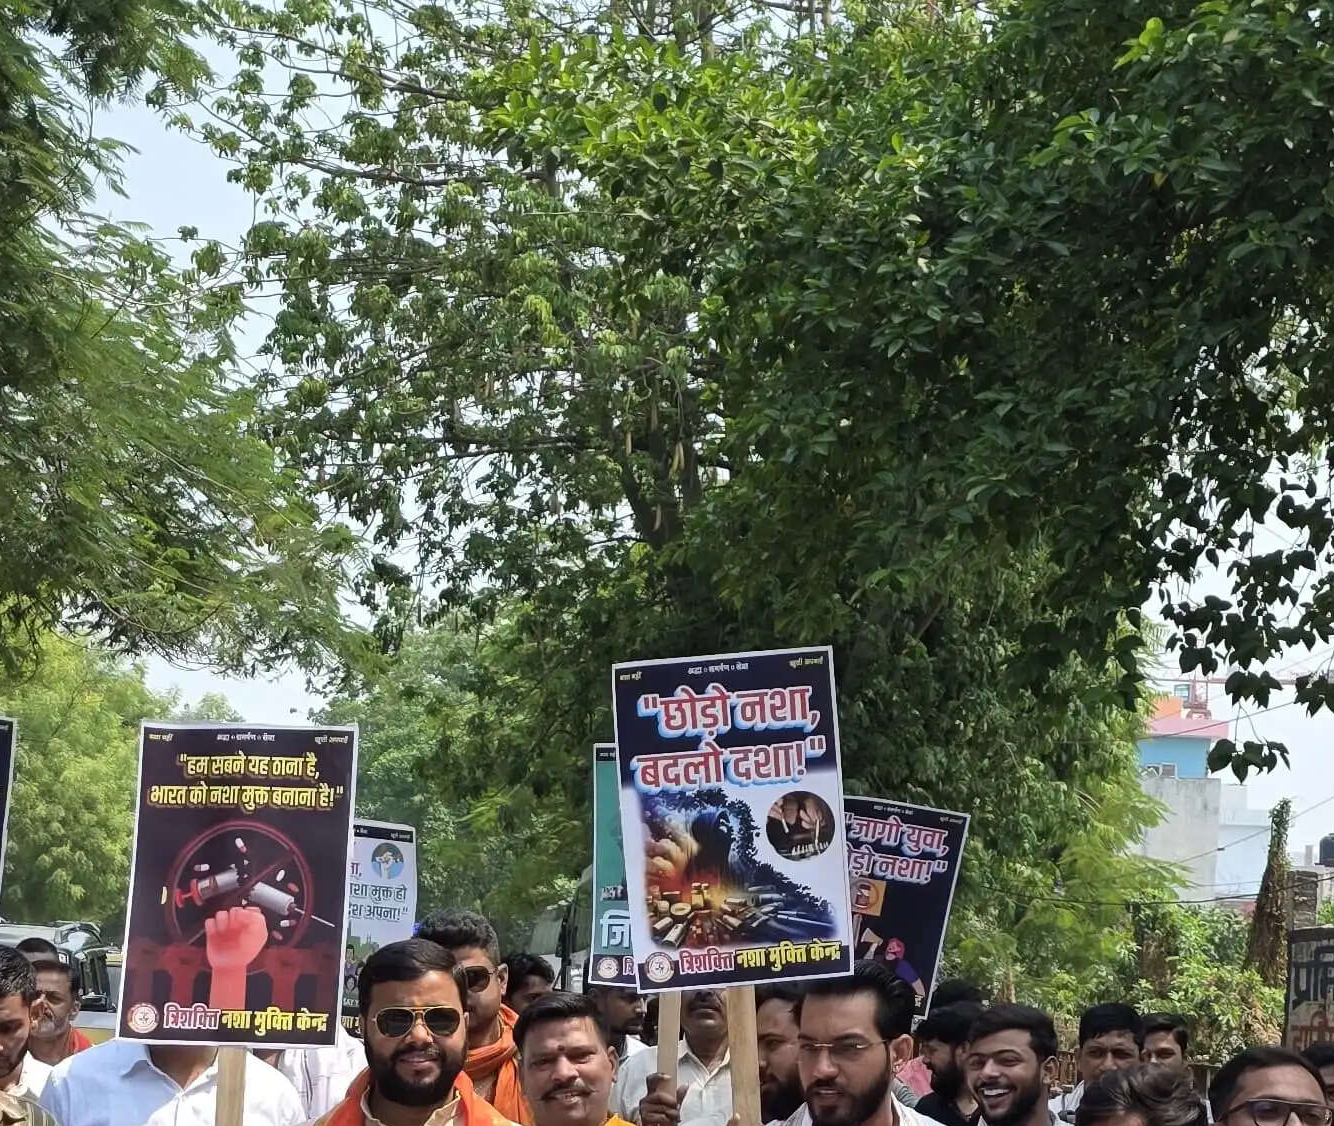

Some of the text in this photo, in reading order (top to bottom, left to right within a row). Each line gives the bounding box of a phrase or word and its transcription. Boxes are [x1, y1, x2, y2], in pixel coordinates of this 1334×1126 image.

[643, 685, 819, 736] "छोड़ो नशा,
[179, 751, 319, 779] "हम सबने यह ठाना है,
[636, 737, 826, 788] बदलो दशा!"
[150, 781, 343, 810] भारत को नशा मुक्त बनाना है!"
[903, 824, 949, 856] युवा,
[875, 853, 948, 884] नशा!"
[395, 884, 407, 900] हो
[367, 904, 408, 920] अपना!"
[736, 948, 767, 968] नशा
[809, 938, 842, 961] केन्द्र
